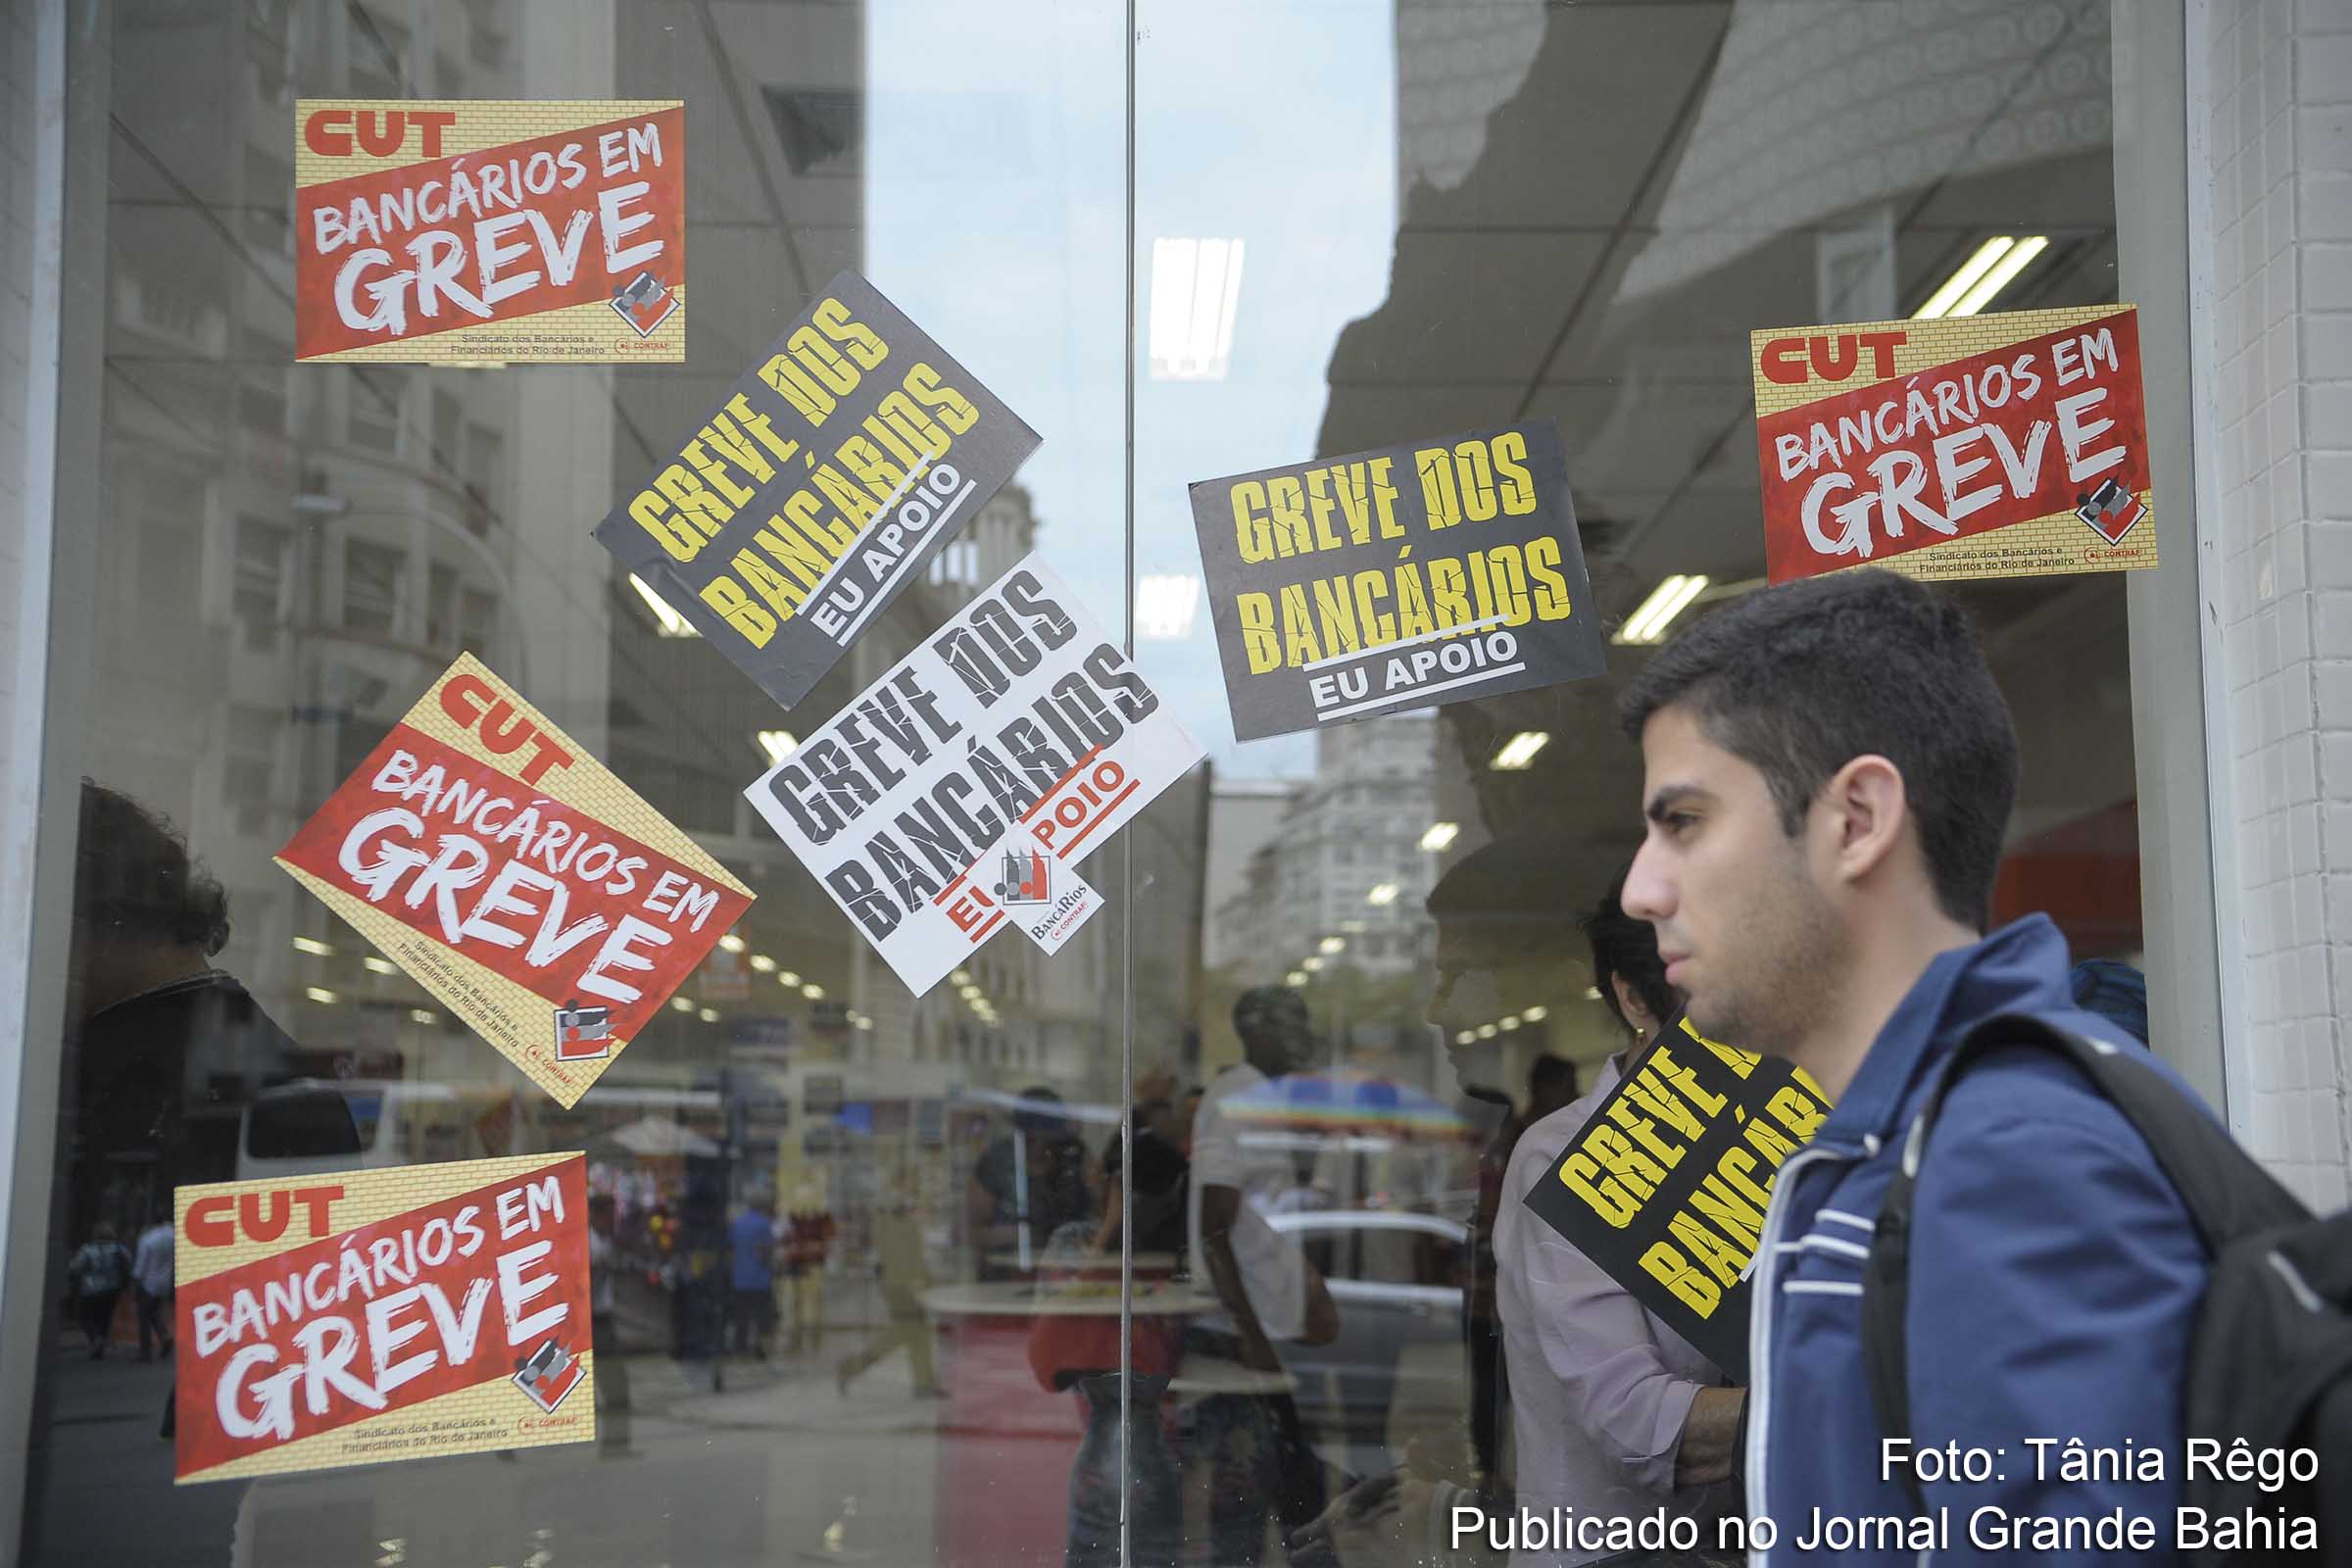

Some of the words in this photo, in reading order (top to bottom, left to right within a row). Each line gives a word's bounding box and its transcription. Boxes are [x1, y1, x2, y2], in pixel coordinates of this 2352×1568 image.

[304, 109, 456, 158] CUT
[313, 143, 588, 255] BANCÁRIOS
[597, 122, 662, 178] EM
[334, 181, 665, 336] GREVE
[627, 392, 801, 564] GREVE
[757, 297, 890, 428] DOS
[1760, 331, 1907, 384] CUT
[1775, 354, 2041, 482] BANCÁRIOS
[2051, 327, 2119, 386] EM
[699, 362, 981, 650] BANCÁRIOS
[1230, 456, 1405, 564] GREVE
[1414, 431, 1537, 531] DOS
[1801, 387, 2127, 558] GREVE
[809, 576, 866, 638] EU
[867, 464, 961, 584] APOIO
[1236, 536, 1571, 675] BANCÁRIOS
[1920, 563, 1982, 573] Financiários
[1984, 561, 1998, 570] do
[2001, 560, 2018, 569] Rio
[2021, 559, 2034, 568] de
[2036, 557, 2075, 566] Janeiro
[1930, 551, 1977, 562] Sindicato
[1981, 549, 1998, 559] dos
[2002, 547, 2053, 557] Bancários
[439, 673, 575, 786] CUT
[768, 665, 963, 846] GREVE
[932, 569, 1078, 709] DOS
[1308, 666, 1370, 709] EU
[1385, 631, 1519, 690] APOIO
[371, 749, 649, 896] BANCÁRIOS
[642, 870, 721, 933] EM
[825, 643, 1159, 942] BANCÁRIOS
[1031, 760, 1125, 851] POIO
[338, 807, 673, 1004] GREVE
[1558, 1045, 1729, 1230] GREVE
[183, 1185, 345, 1248] CUT
[193, 1205, 485, 1358] BANCÁRIOS
[495, 1175, 565, 1241] EM
[216, 1240, 569, 1440] GREVE
